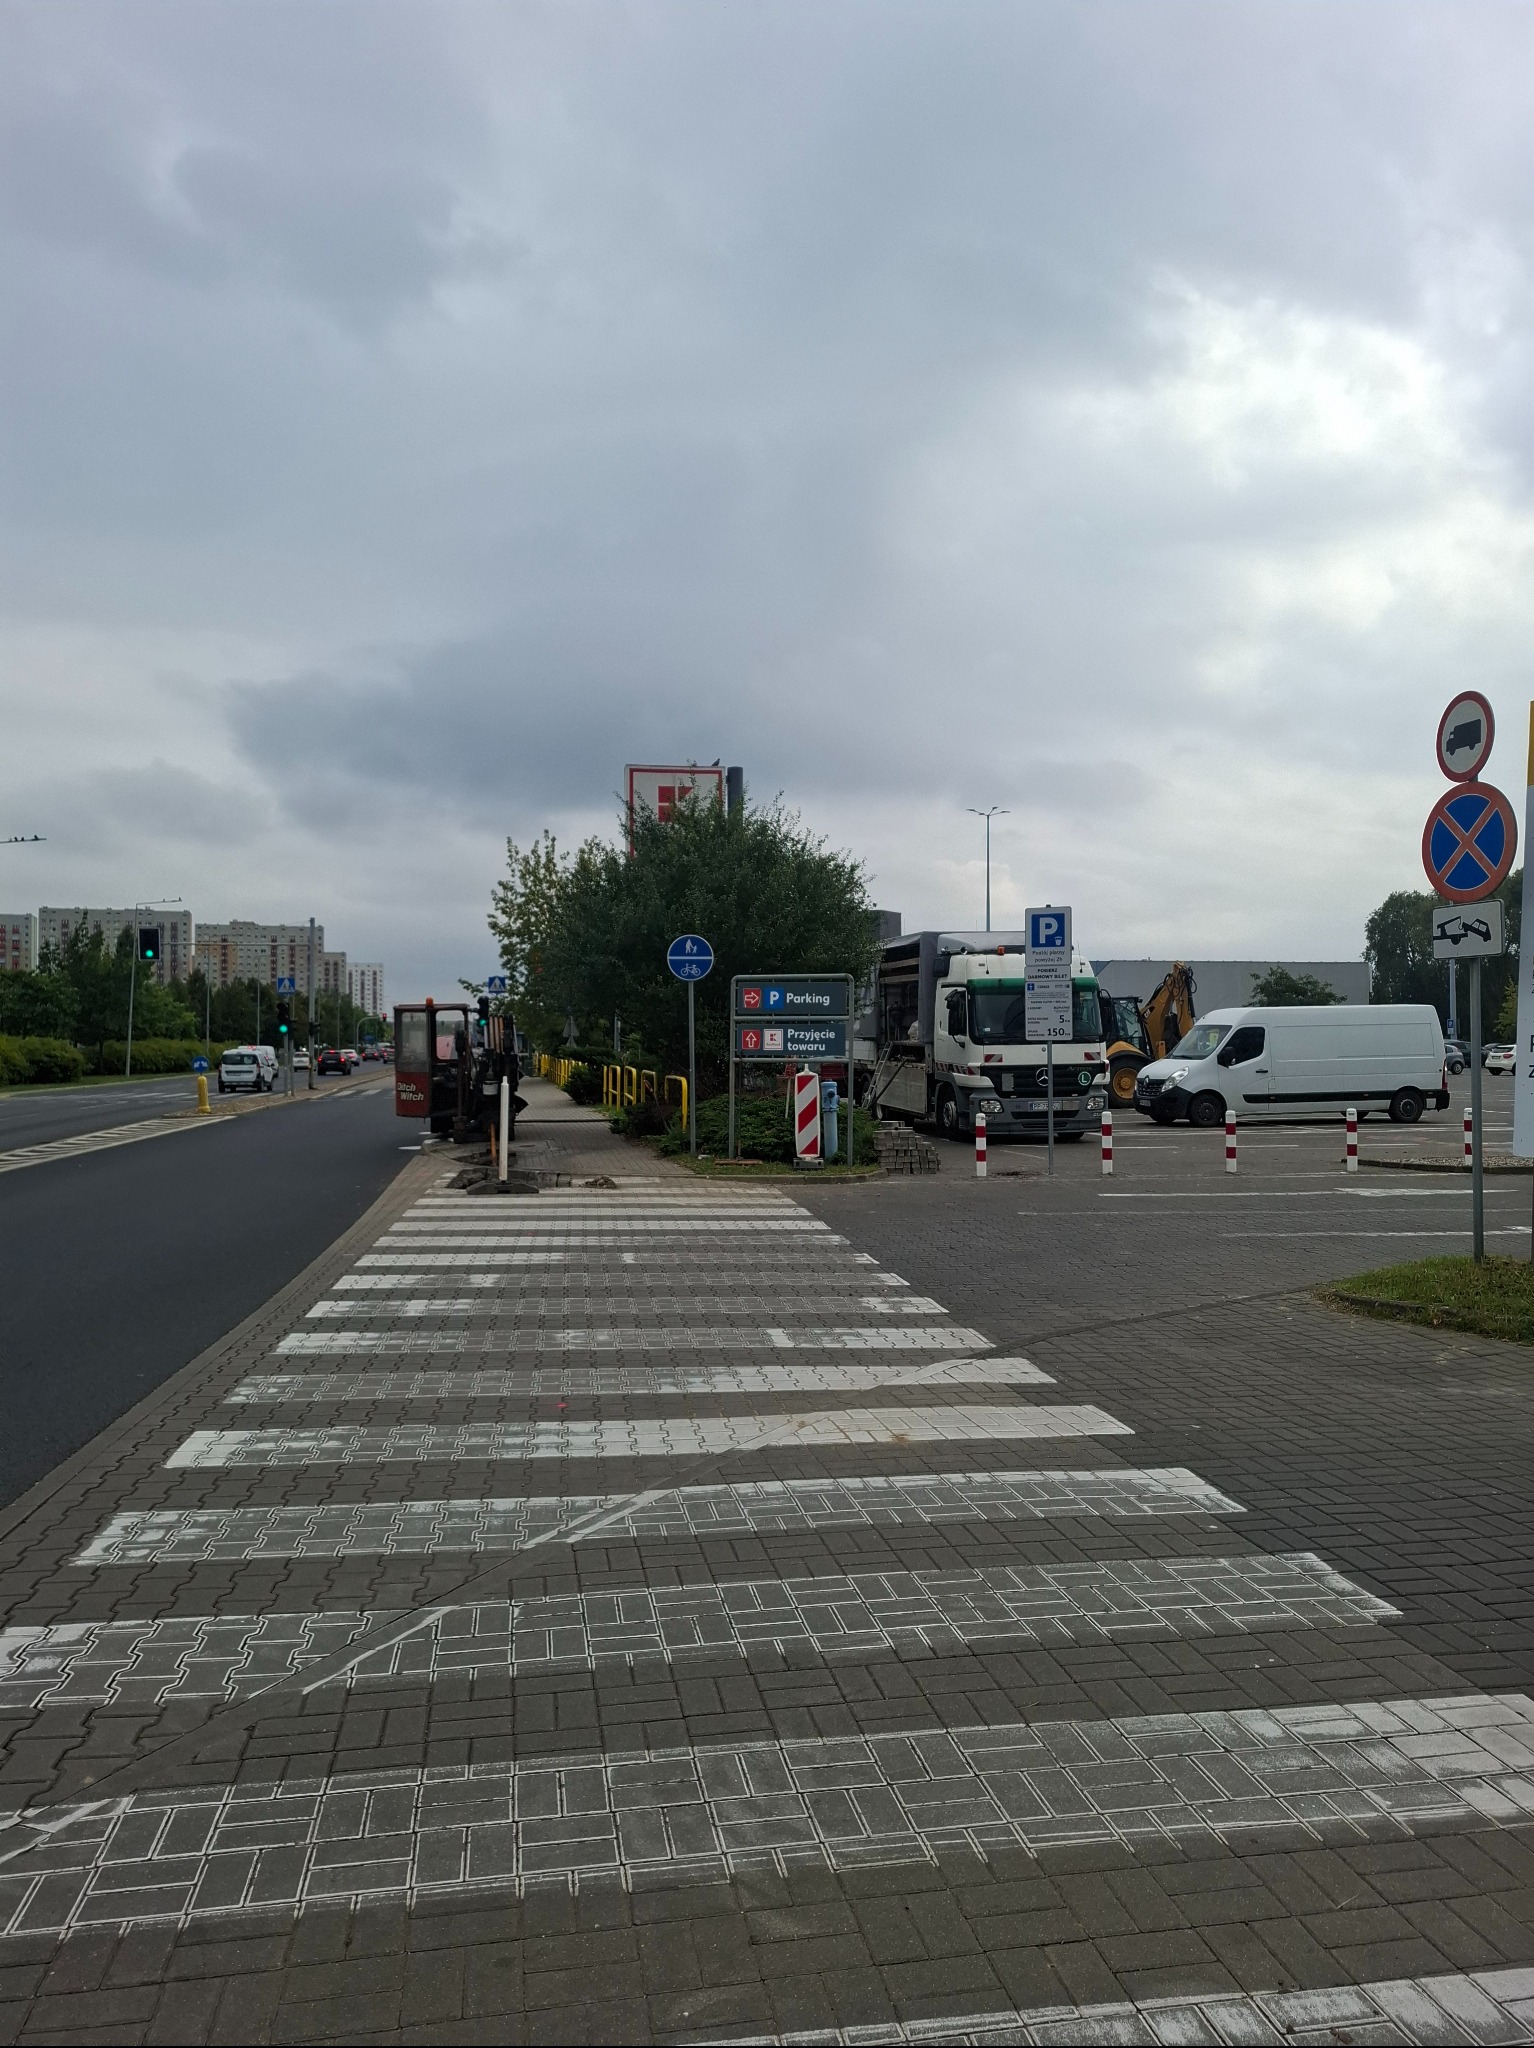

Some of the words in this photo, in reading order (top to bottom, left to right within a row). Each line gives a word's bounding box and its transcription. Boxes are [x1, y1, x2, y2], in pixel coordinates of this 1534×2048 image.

[1039, 917, 1058, 944] P
[770, 991, 780, 1005] P
[786, 992, 830, 1006] Parking
[1059, 1014, 1065, 1023] 5
[787, 1028, 836, 1041] Przyjęcie
[1047, 1027, 1065, 1037] 150
[787, 1041, 826, 1051] towaru
[397, 1082, 417, 1092] Ditch
[400, 1091, 425, 1101] Witch
